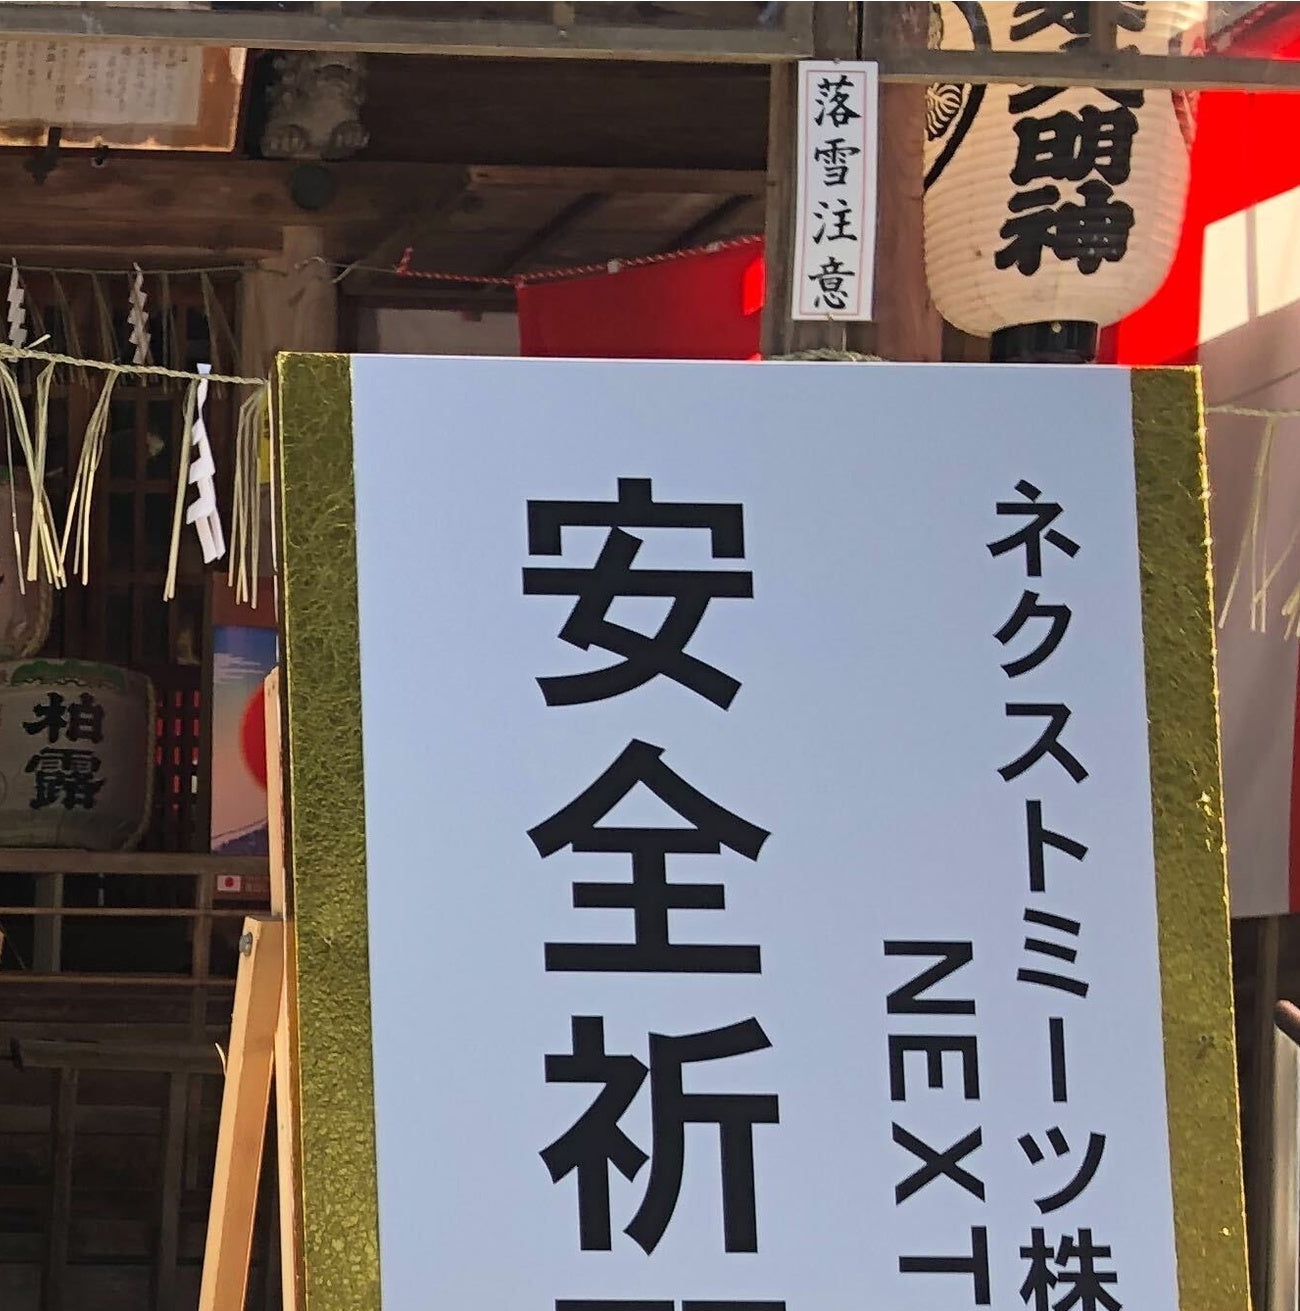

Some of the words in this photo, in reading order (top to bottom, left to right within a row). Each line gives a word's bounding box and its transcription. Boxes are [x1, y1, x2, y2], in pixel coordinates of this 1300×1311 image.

[808, 75, 863, 311] 落雪注意
[22, 692, 106, 811] 柏露
[883, 940, 992, 1306] NEXT
